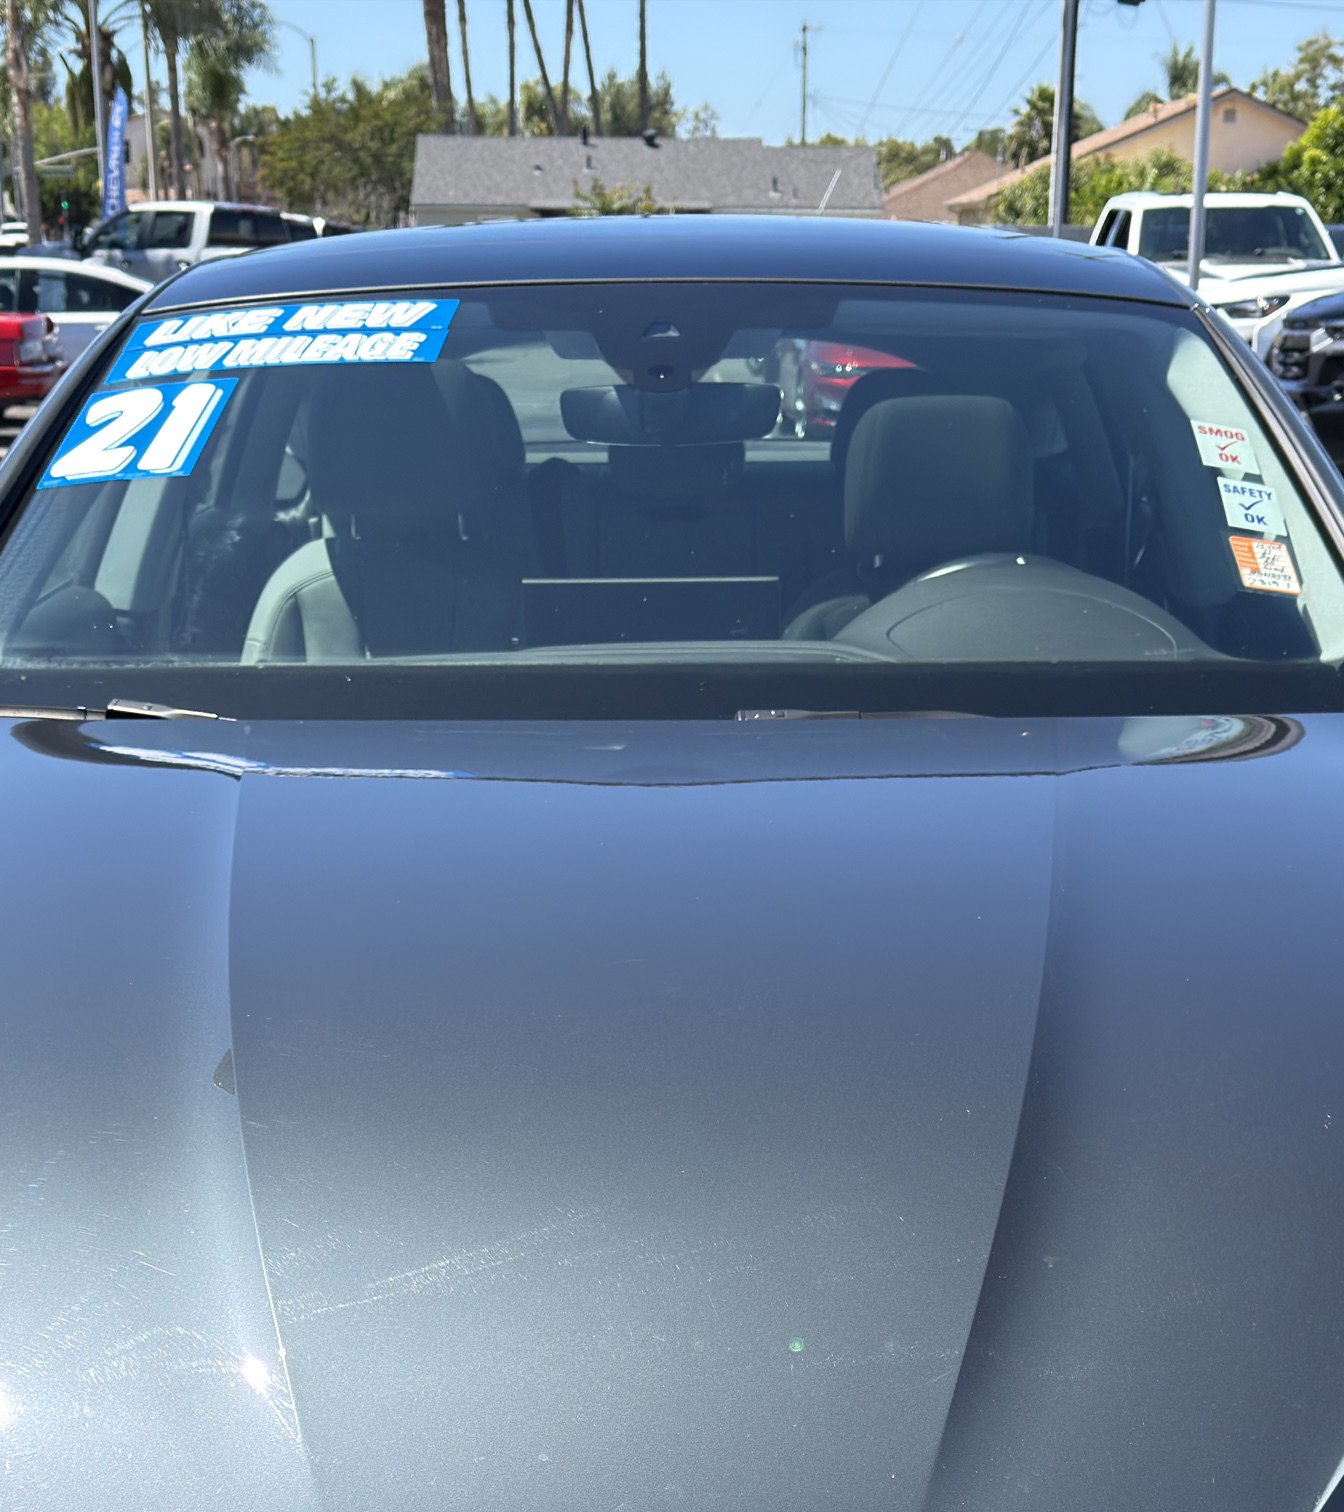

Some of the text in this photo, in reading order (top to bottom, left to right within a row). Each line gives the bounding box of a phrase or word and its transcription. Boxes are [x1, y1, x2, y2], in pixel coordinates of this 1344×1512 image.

[143, 301, 438, 347] LIKE NEW
[125, 331, 427, 379] LOW MILEAGE
[51, 383, 224, 480] 21
[1197, 425, 1246, 442] SMOG
[1218, 452, 1241, 464] OK
[1222, 484, 1272, 501] SAFETY
[1244, 513, 1267, 525] OK
